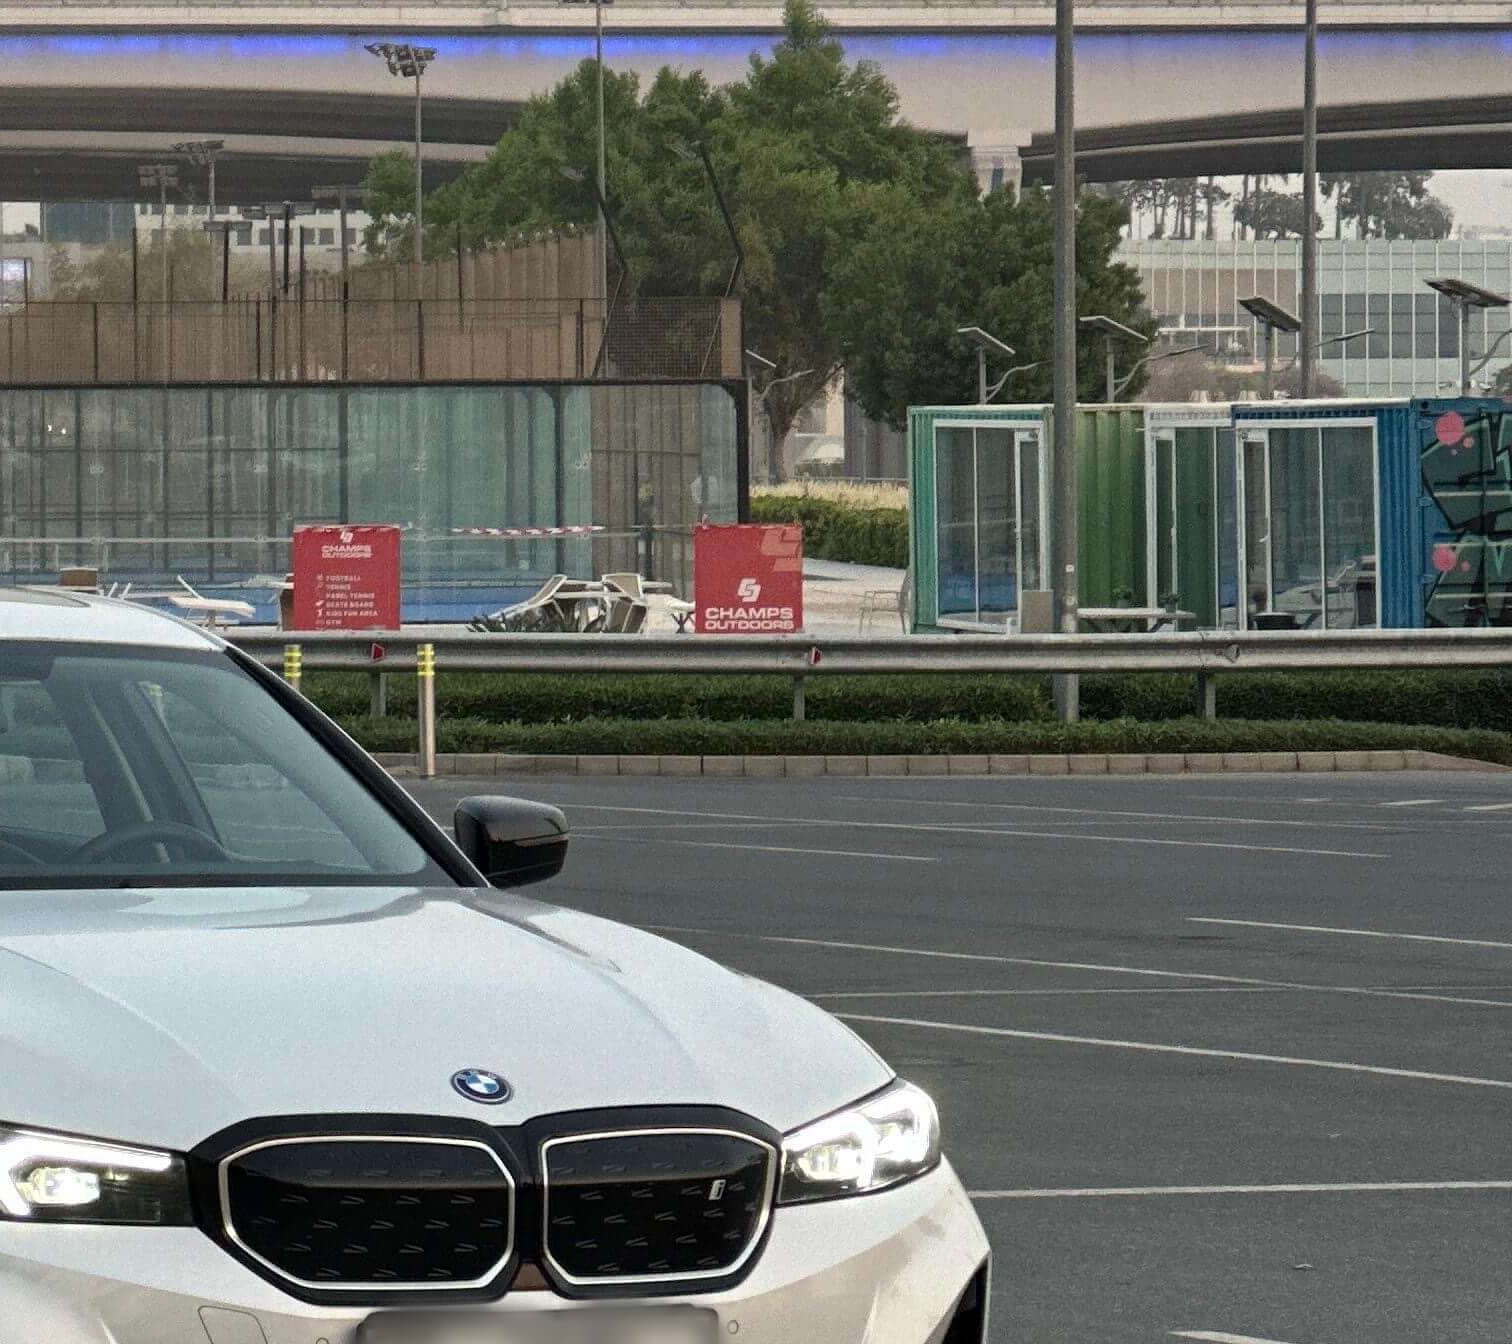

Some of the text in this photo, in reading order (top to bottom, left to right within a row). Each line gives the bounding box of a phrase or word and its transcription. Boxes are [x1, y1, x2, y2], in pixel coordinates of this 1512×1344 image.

[321, 545, 371, 553] CHAMPS
[705, 607, 793, 619] CHAMPS
[705, 620, 794, 630] OUTDOORS
